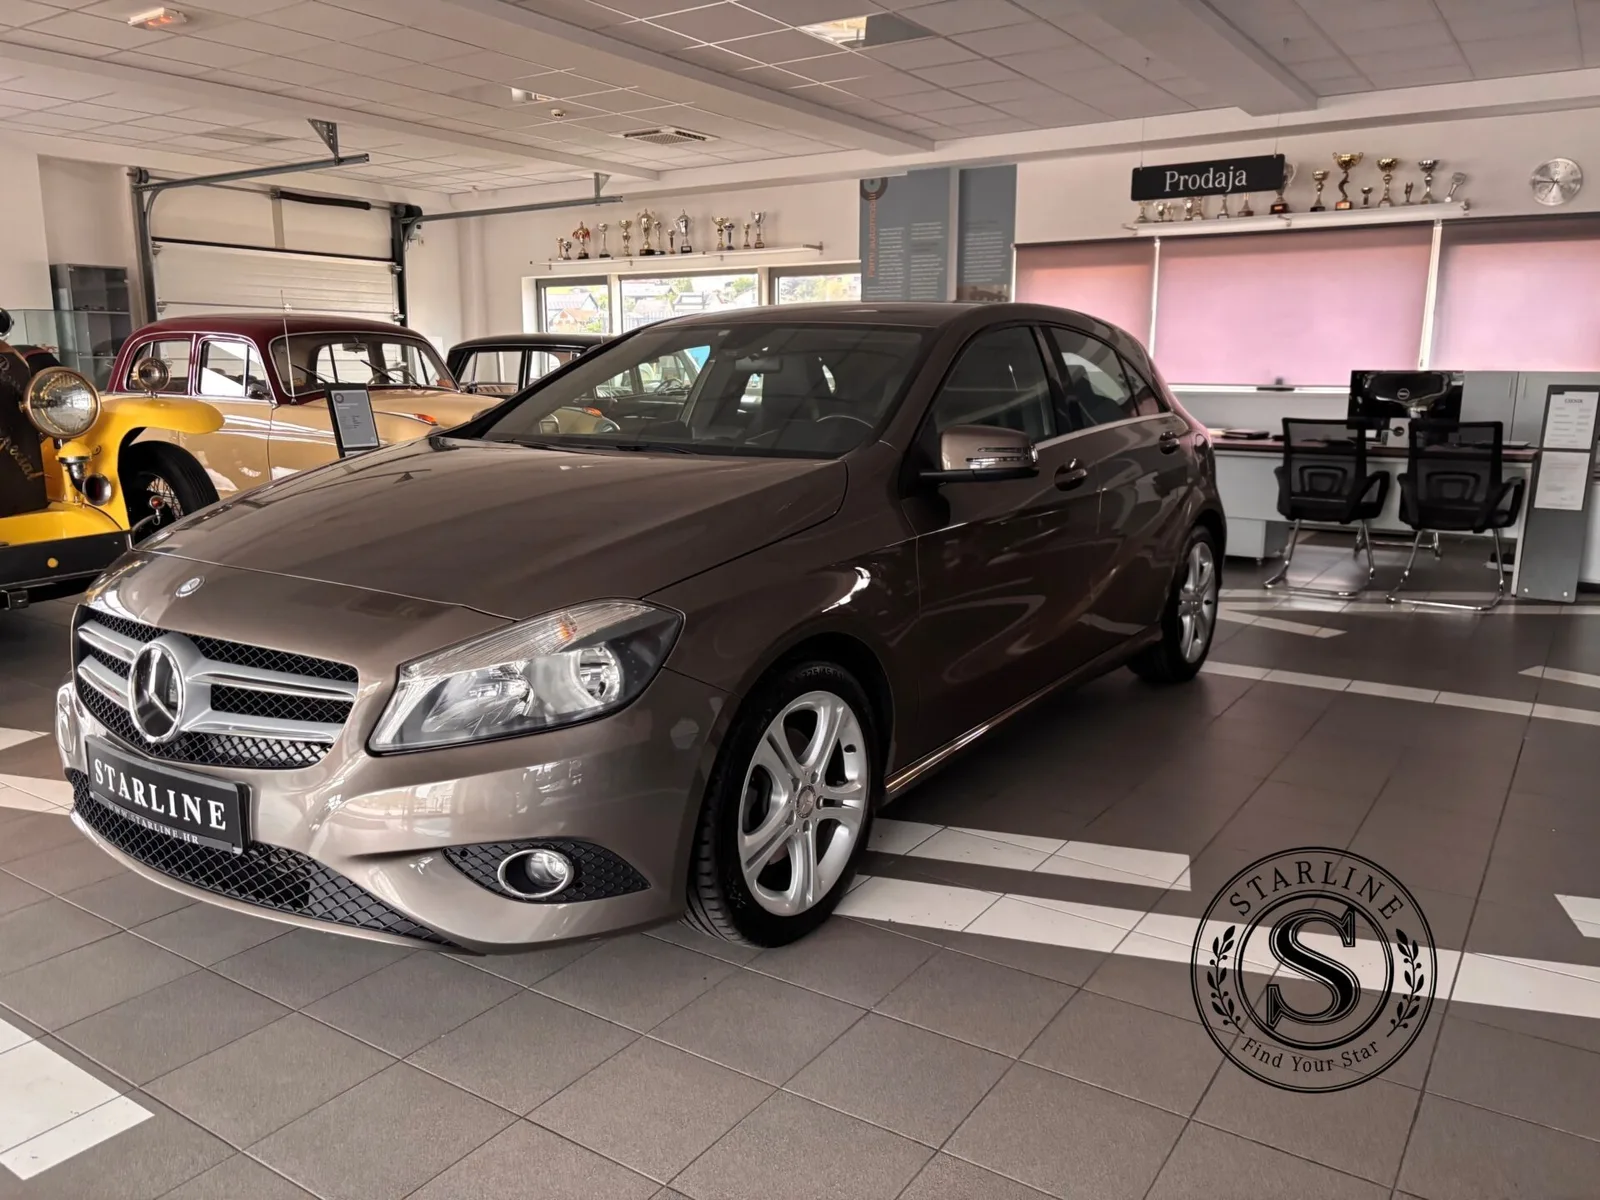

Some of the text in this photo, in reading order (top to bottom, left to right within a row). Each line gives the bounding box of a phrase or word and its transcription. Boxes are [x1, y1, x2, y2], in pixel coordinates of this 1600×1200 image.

[1164, 166, 1247, 192] Prodaja
[94, 758, 226, 830] STARLINE
[108, 803, 199, 844] WWW.STARLINE.HR
